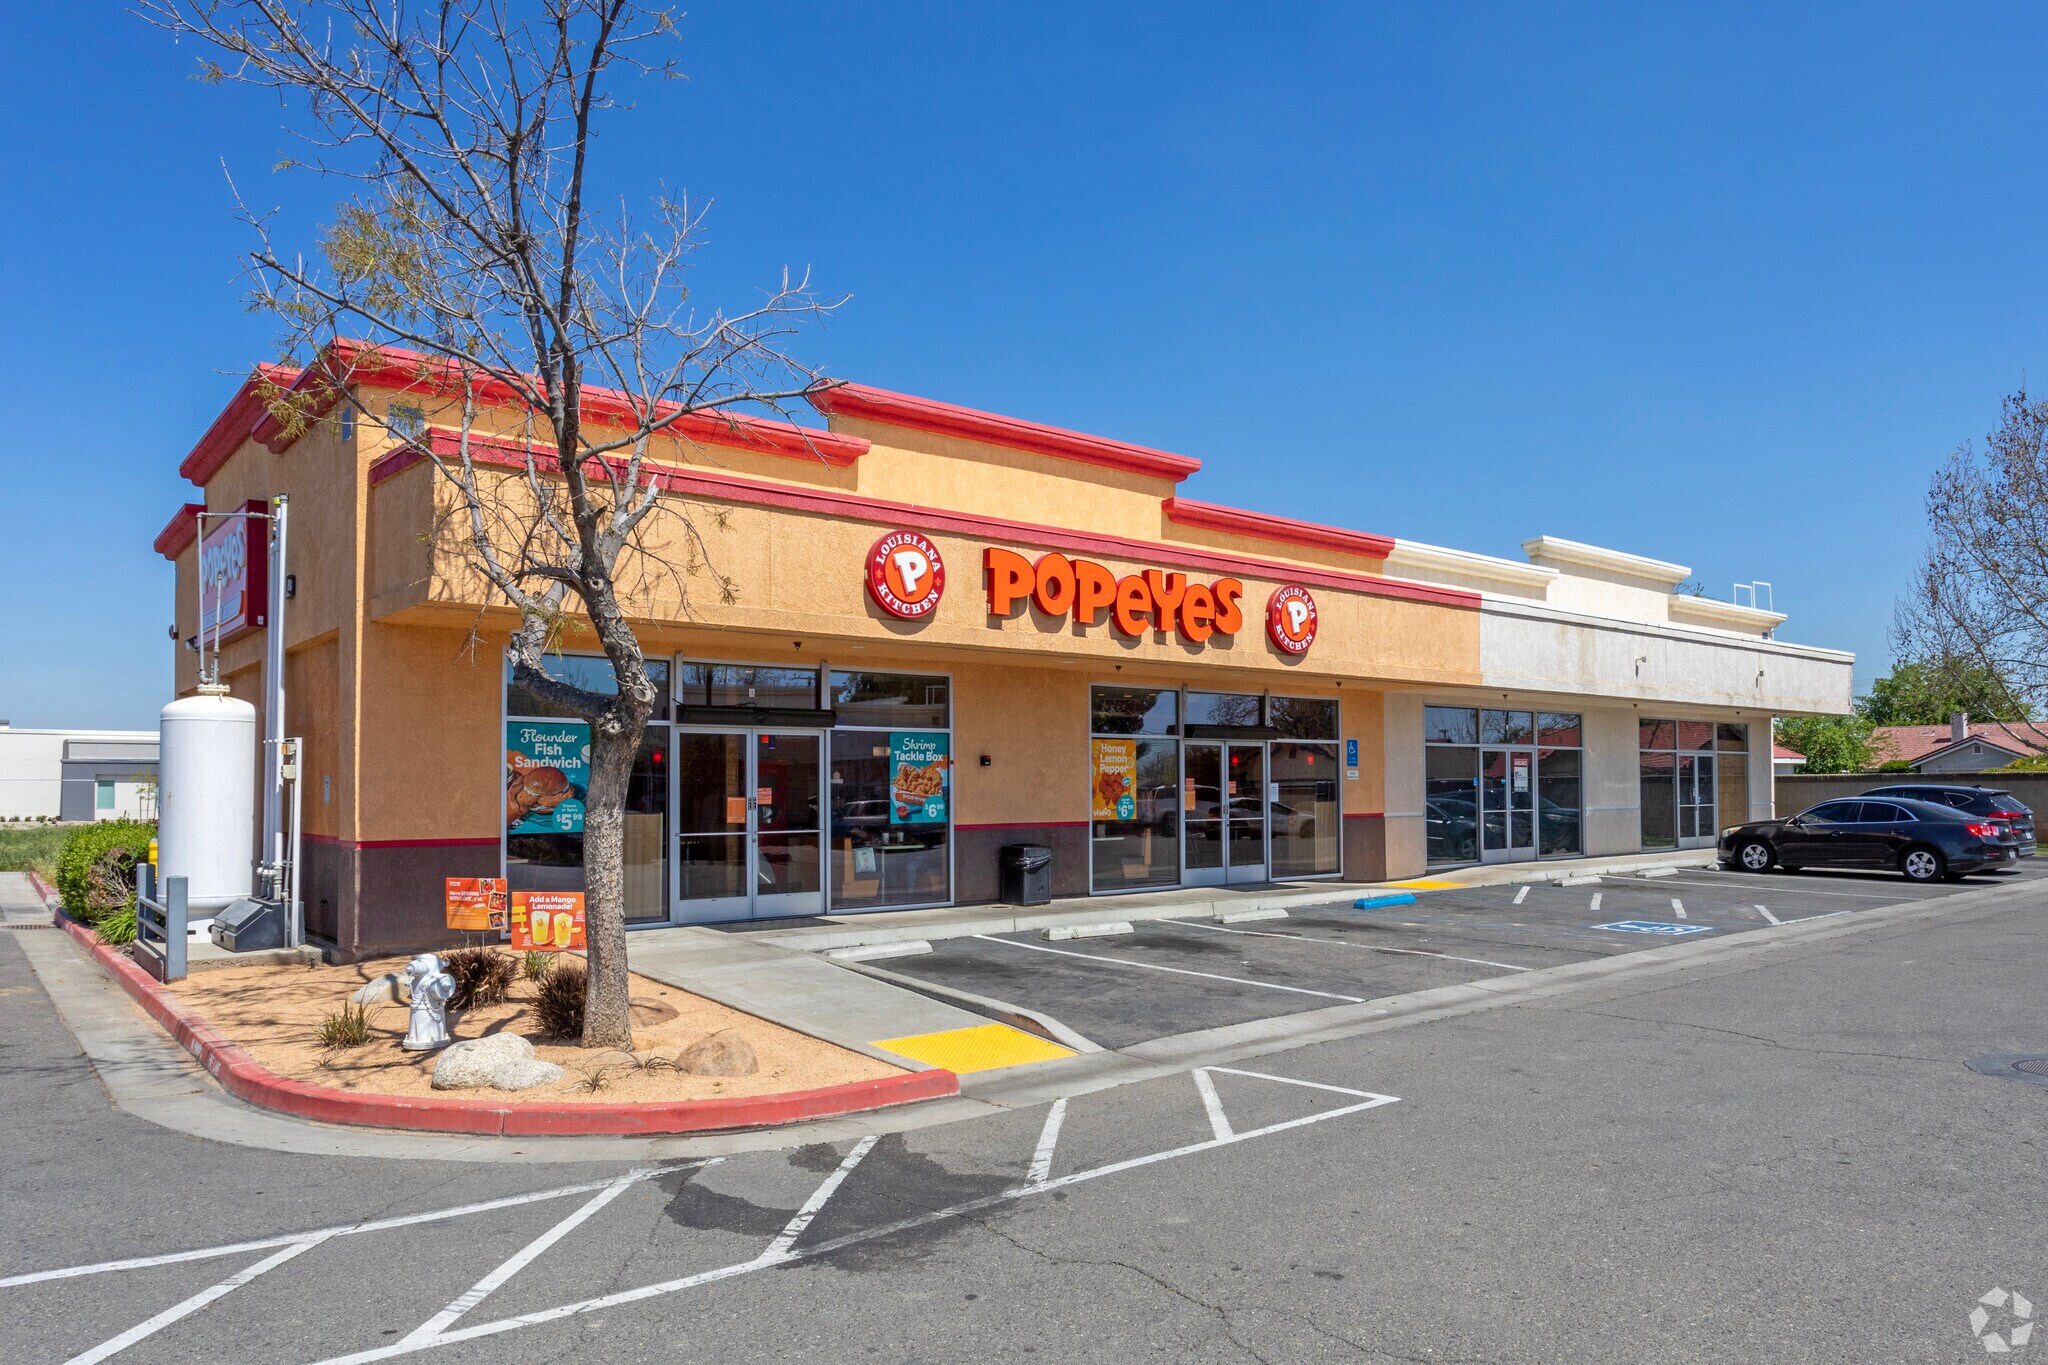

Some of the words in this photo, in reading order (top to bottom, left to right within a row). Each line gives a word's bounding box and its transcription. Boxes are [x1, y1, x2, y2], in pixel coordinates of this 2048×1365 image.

[876, 534, 941, 572] LOUISIANA
[892, 551, 928, 594] P
[878, 582, 939, 614] KITCHEN
[1276, 588, 1316, 619] LOUISIANA
[1287, 601, 1308, 634] P
[1276, 624, 1313, 650] KITCHEN
[520, 728, 578, 743] Flounder
[535, 743, 562, 755] Fish
[902, 737, 936, 754] Shrimp
[1101, 744, 1126, 754] Honey
[515, 756, 581, 768] Sandwich
[894, 751, 924, 761] Tackle
[926, 752, 943, 761] Box
[1100, 753, 1127, 763] Lemon
[1100, 764, 1127, 774] Pepper
[551, 896, 576, 904] Mango
